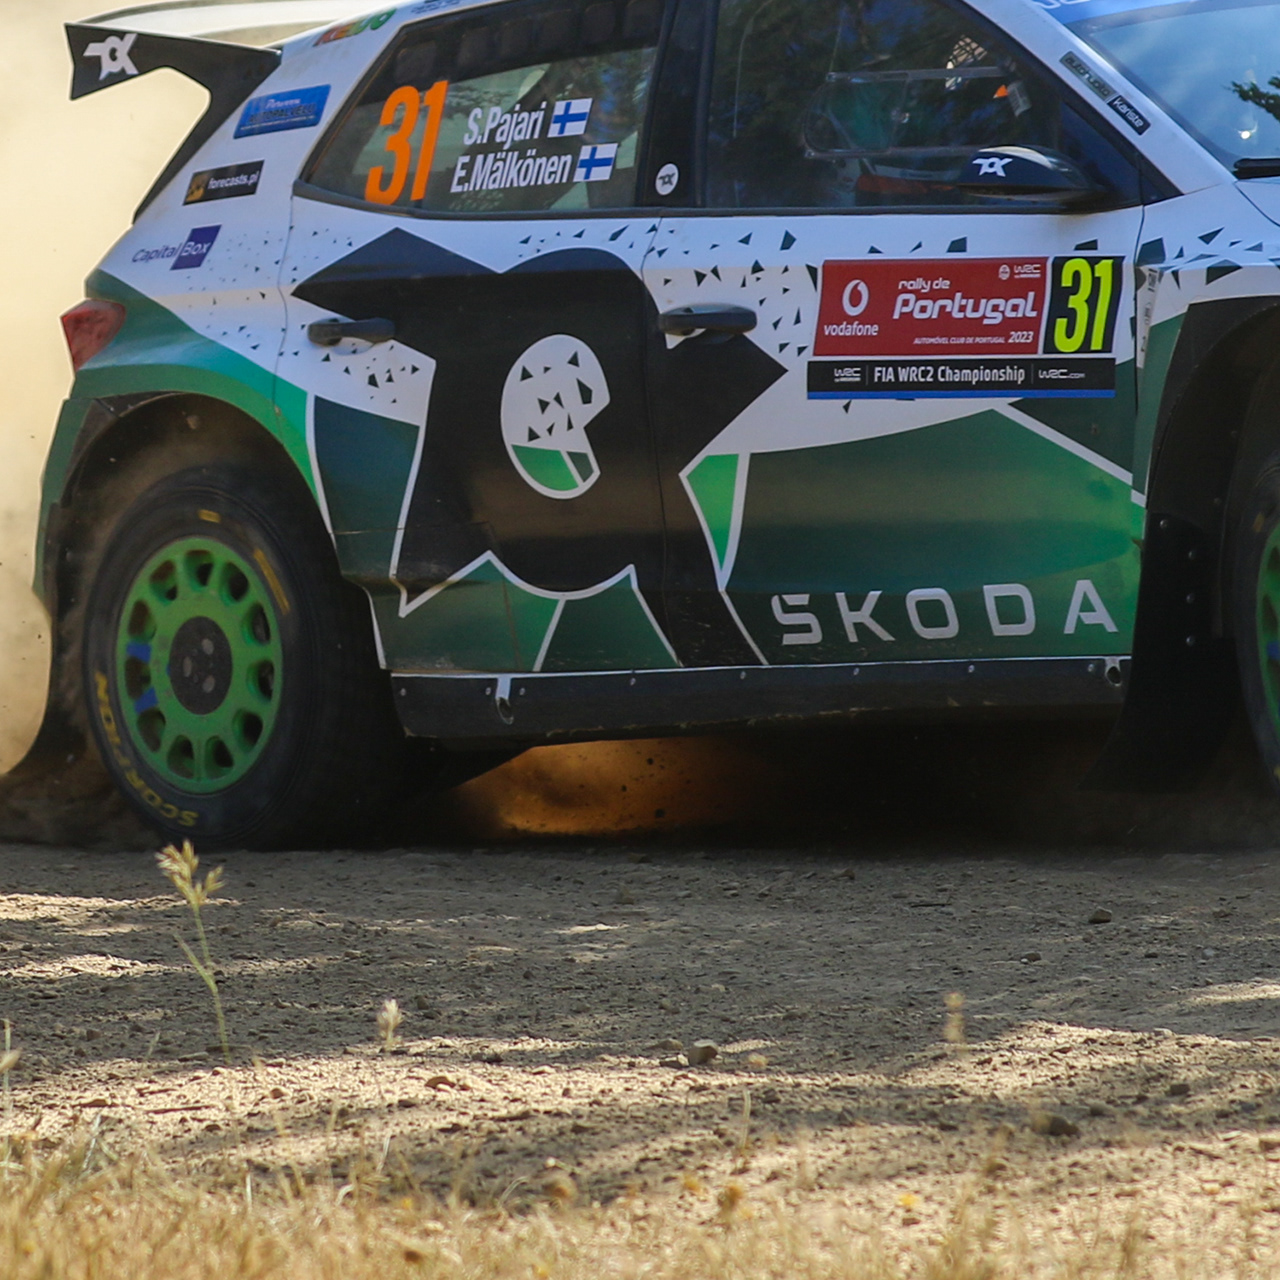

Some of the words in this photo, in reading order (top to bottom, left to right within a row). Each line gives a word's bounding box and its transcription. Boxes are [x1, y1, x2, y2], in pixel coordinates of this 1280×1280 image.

[463, 101, 546, 150] S.Pajari
[364, 80, 449, 206] 31
[207, 171, 260, 190] forecasts.pl
[450, 148, 572, 194] E.Mälkönen
[898, 278, 930, 292] rally
[932, 279, 950, 290] de
[892, 292, 1037, 325] Portugal
[1054, 258, 1114, 353] 31
[823, 321, 878, 336] vodafone
[1008, 331, 1034, 343] 2023
[874, 367, 894, 382] FIA
[898, 366, 933, 382] WRC2
[938, 366, 1025, 385] Championship
